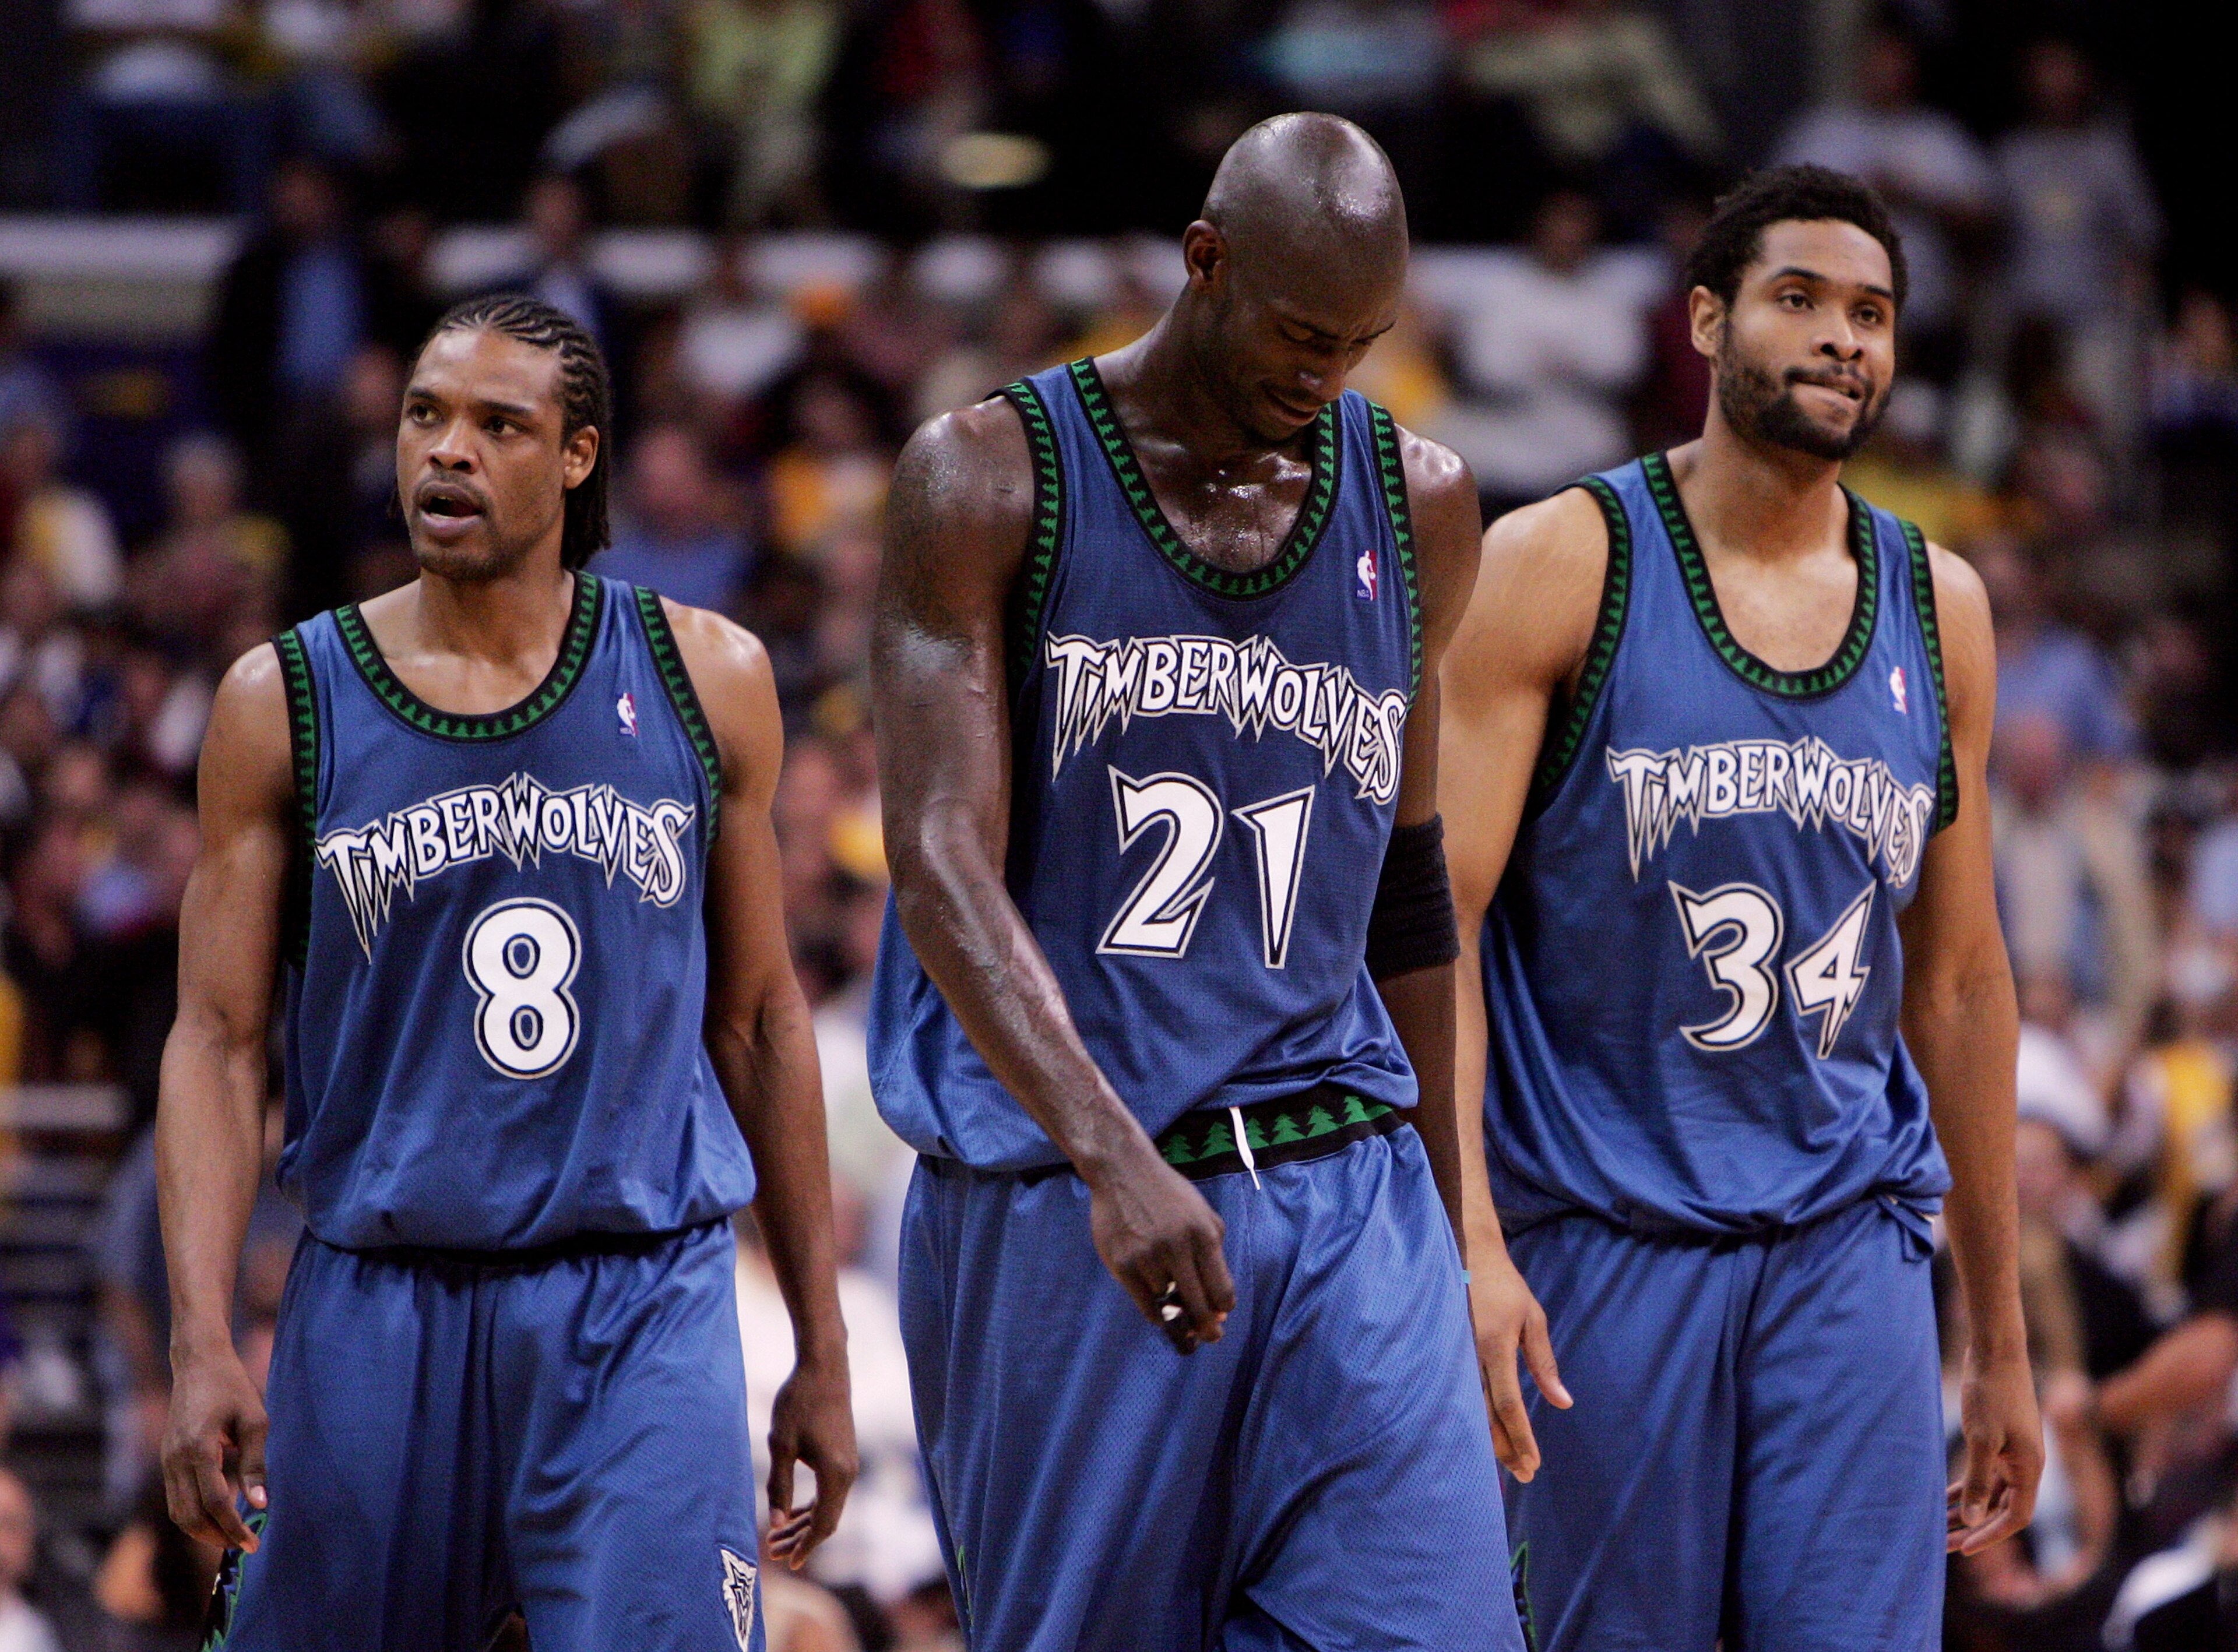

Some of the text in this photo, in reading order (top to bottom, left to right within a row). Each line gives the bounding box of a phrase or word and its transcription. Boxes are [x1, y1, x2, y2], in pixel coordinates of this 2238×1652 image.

[1096, 764, 1315, 968] 21
[462, 897, 581, 1079] 8
[1668, 880, 1877, 1059] 34
